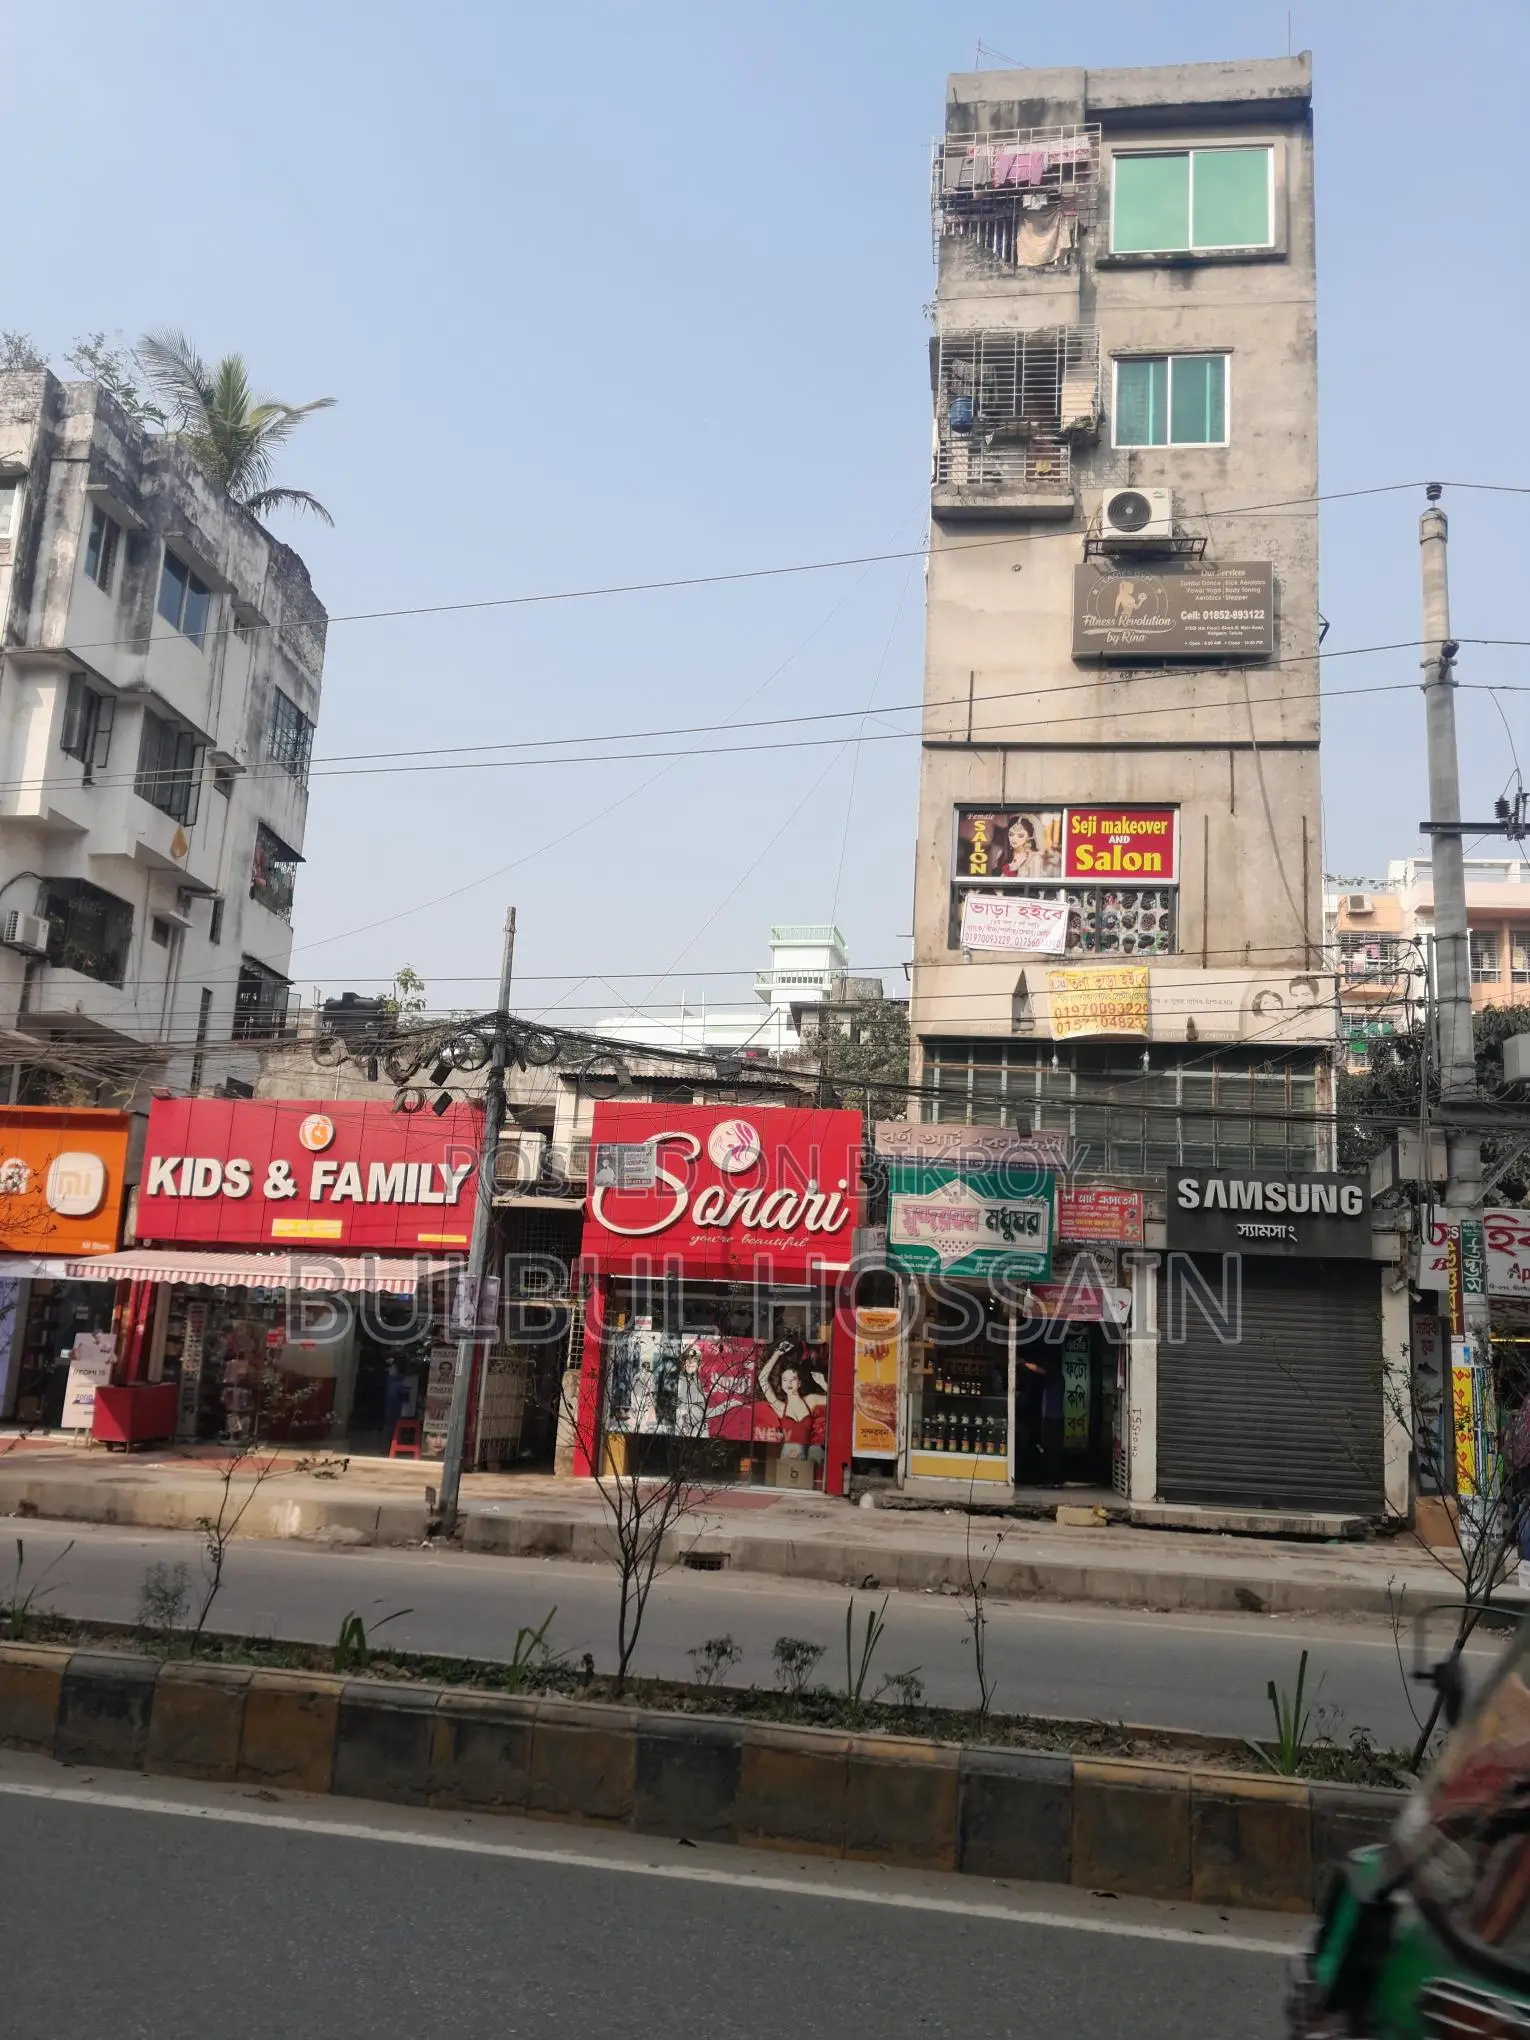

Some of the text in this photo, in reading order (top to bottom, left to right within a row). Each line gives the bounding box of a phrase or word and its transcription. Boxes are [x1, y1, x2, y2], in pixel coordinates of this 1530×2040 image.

[1082, 614, 1171, 627] Fitness Revolution
[1180, 610, 1265, 620] Cell: 01852-893122
[1106, 631, 1120, 645] by
[967, 813, 995, 821] Female
[1072, 815, 1168, 836] Seji makeover
[969, 820, 988, 874] SALON
[1108, 835, 1131, 844] AND
[1076, 845, 1162, 872] Salon
[970, 902, 1064, 920] ভাড়া হইবে
[918, 1130, 962, 1147] আর্ট
[146, 1156, 473, 1204] KIDS & FAMILY
[591, 1131, 850, 1236] Sonari
[1177, 1178, 1364, 1217] SAMSUNG
[984, 1206, 1042, 1243] মধুঘর
[1236, 1223, 1299, 1243] স্যামসাং
[741, 1233, 810, 1249] beautiful
